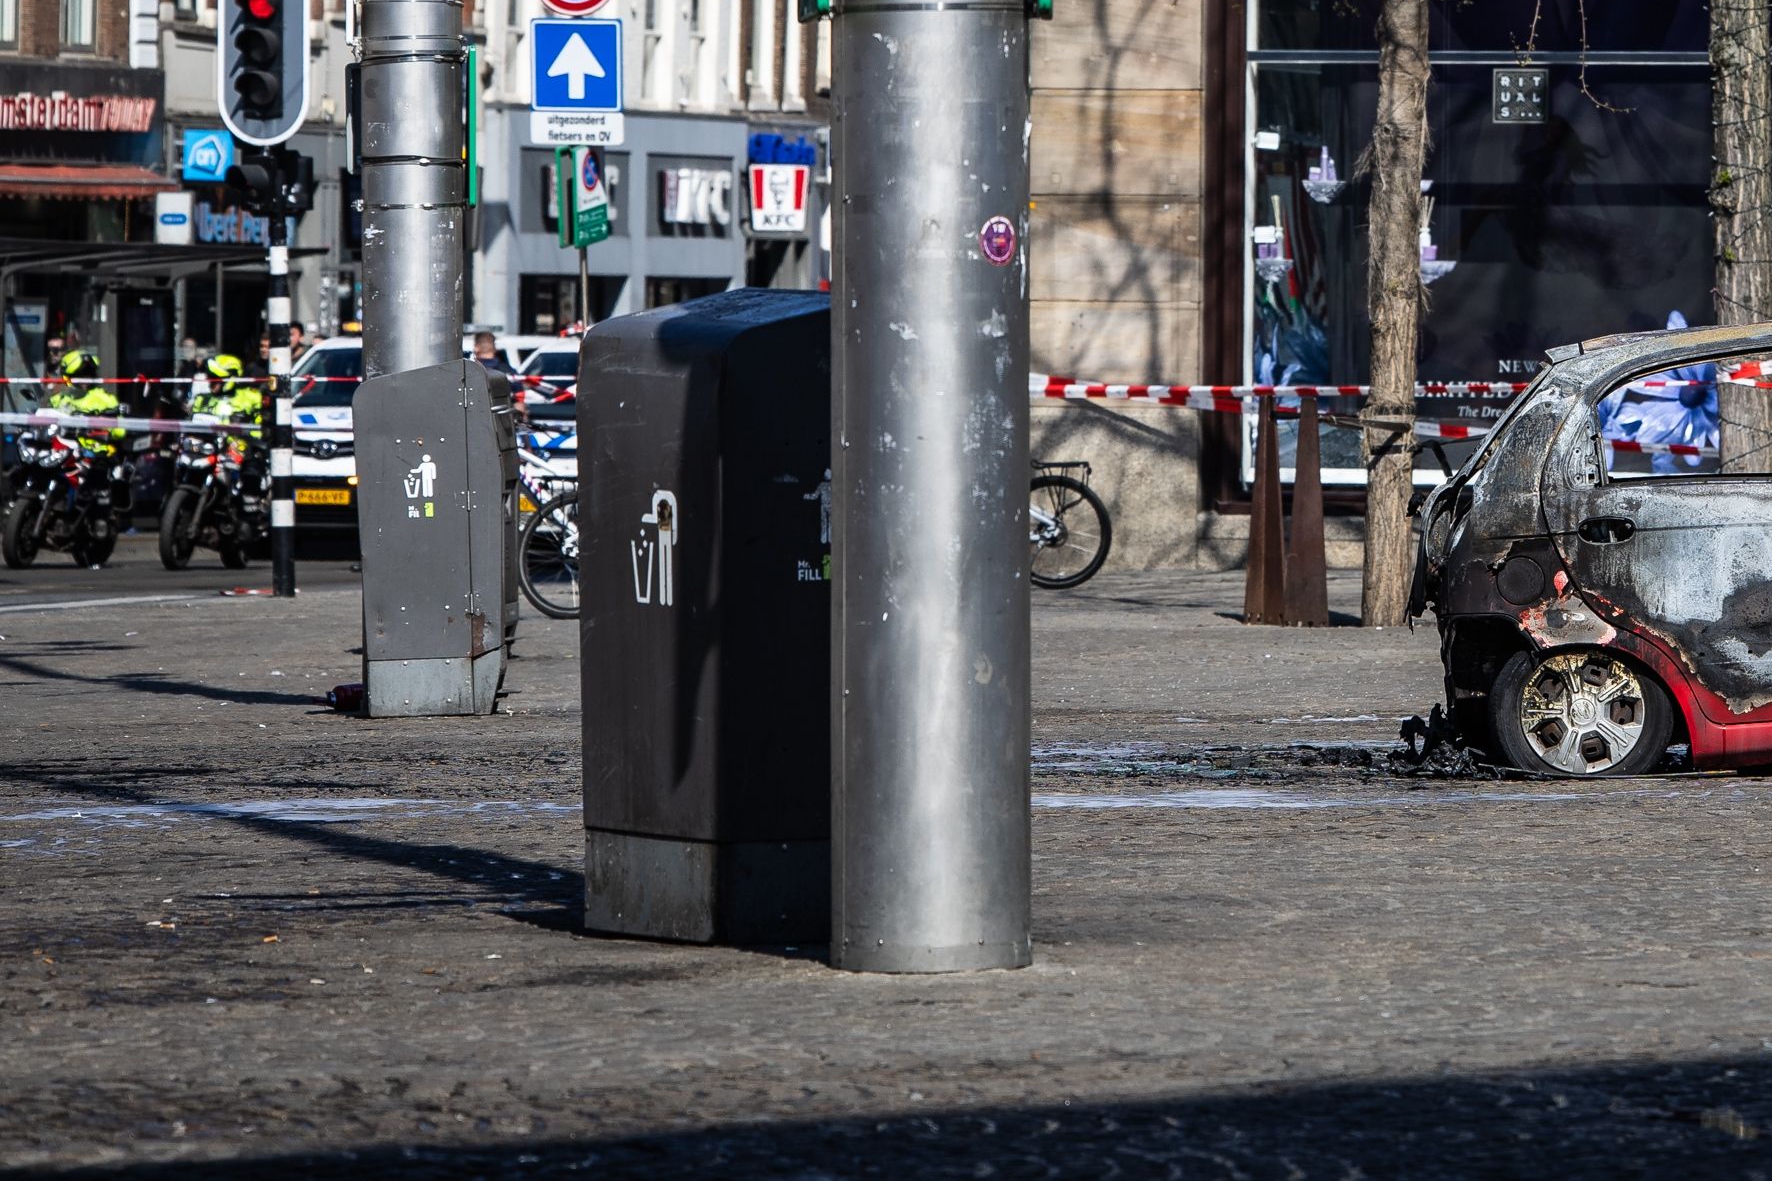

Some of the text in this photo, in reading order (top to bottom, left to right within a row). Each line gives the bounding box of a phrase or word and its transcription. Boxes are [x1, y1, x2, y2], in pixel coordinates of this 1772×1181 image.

[547, 115, 606, 127] uitgezonderd
[547, 131, 612, 141] fietsers en OV
[762, 213, 796, 227] KFC
[1498, 360, 1540, 373] NEW
[1457, 406, 1479, 417] The
[797, 560, 811, 569] Mr.
[797, 569, 822, 581] FILL
